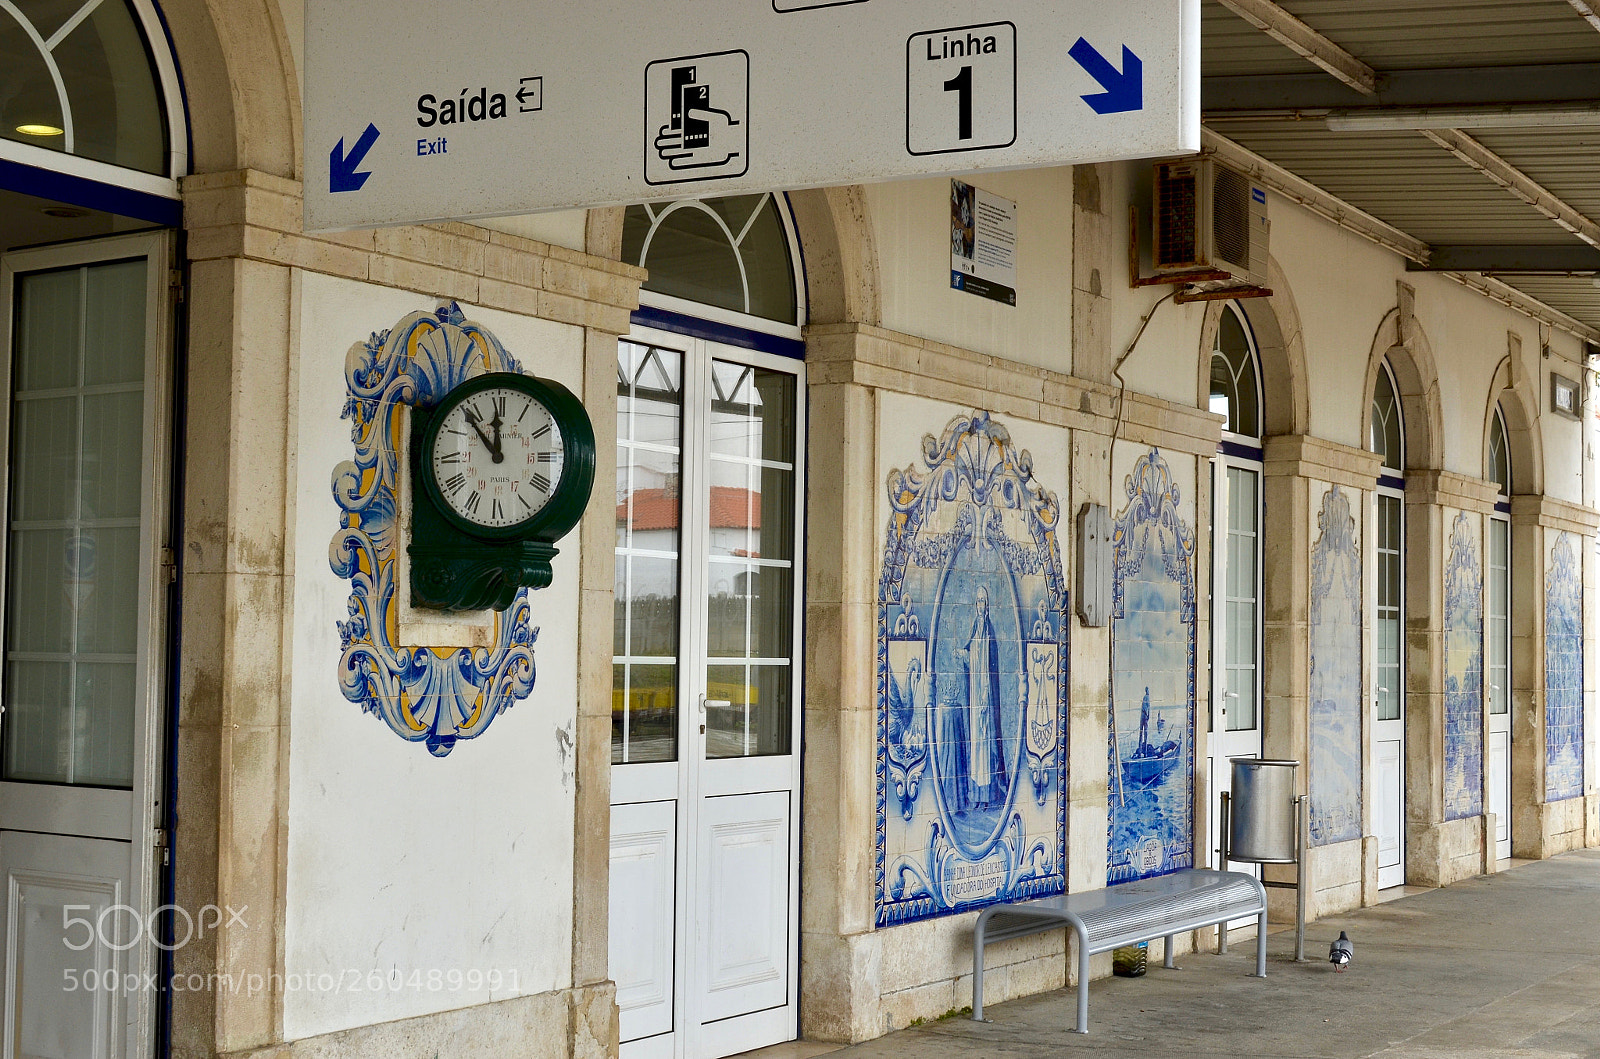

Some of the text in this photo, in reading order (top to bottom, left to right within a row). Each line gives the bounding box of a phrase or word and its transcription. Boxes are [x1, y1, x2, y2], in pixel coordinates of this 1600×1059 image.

[926, 33, 997, 60] Linha
[416, 87, 507, 128] Saída
[943, 66, 972, 140] 1
[417, 136, 448, 156] Exit
[490, 476, 510, 484] PARIS
